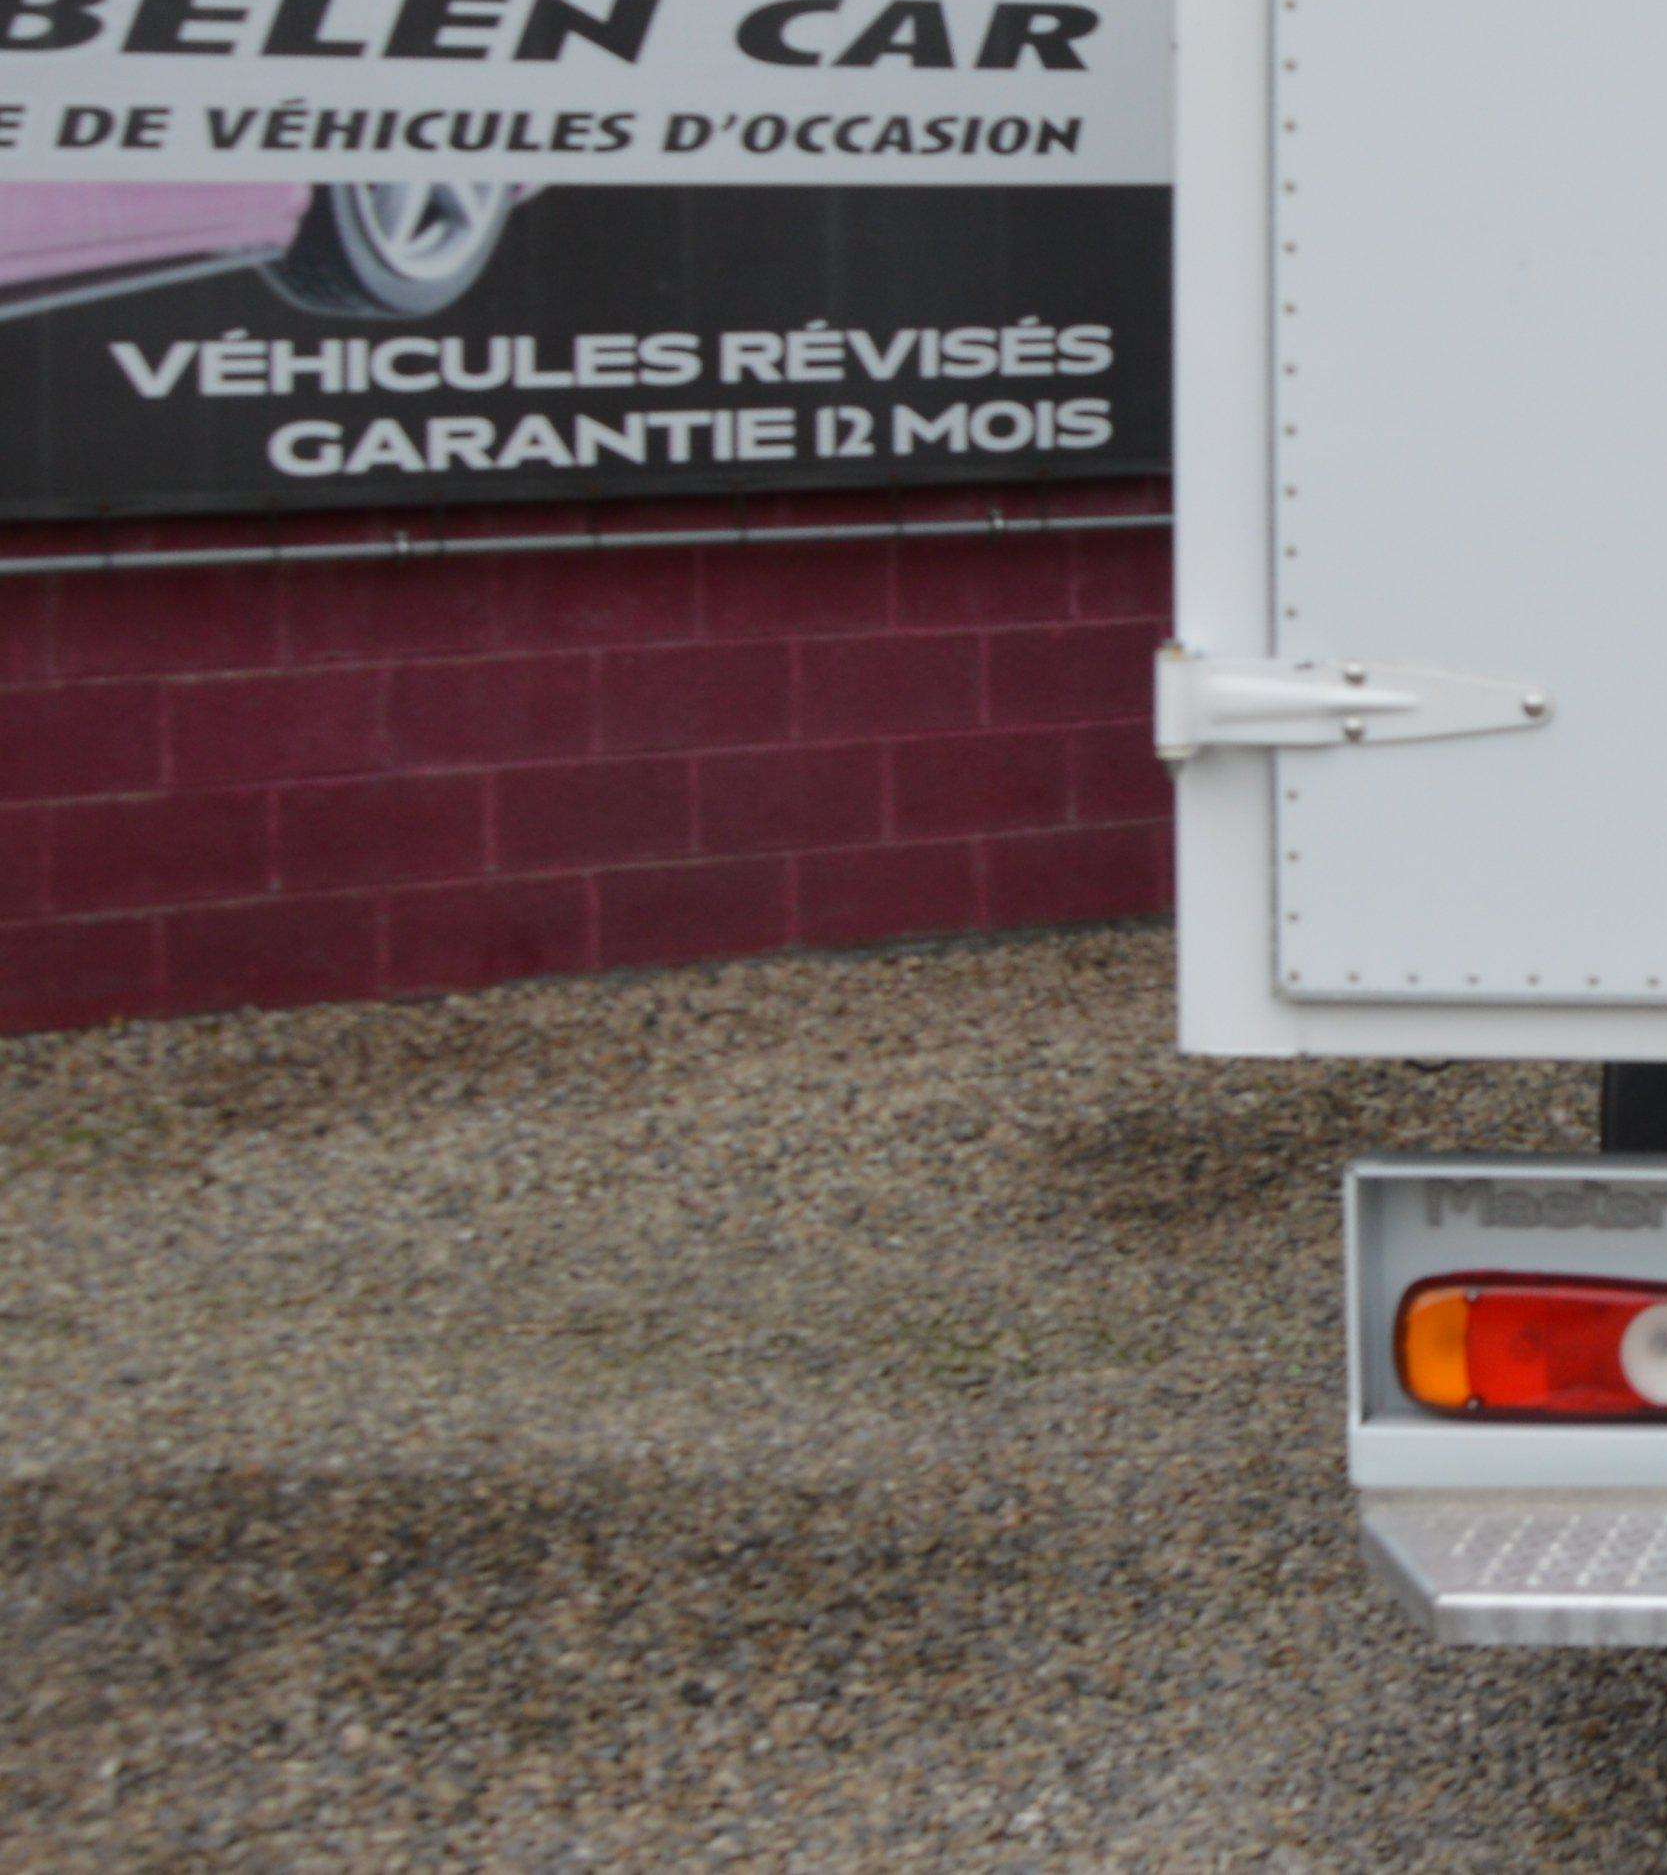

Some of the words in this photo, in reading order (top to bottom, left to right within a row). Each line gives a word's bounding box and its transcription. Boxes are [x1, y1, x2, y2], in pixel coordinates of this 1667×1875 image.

[55, 105, 171, 150] DE
[206, 99, 635, 153] VÉHICULES
[662, 113, 1082, 156] D'OCCASION
[111, 328, 702, 399] VÉHICULES
[720, 316, 1113, 384] RÉVISÉS
[267, 407, 797, 477] GARANTIE
[815, 405, 875, 458] 12
[892, 398, 1112, 455] MOIS
